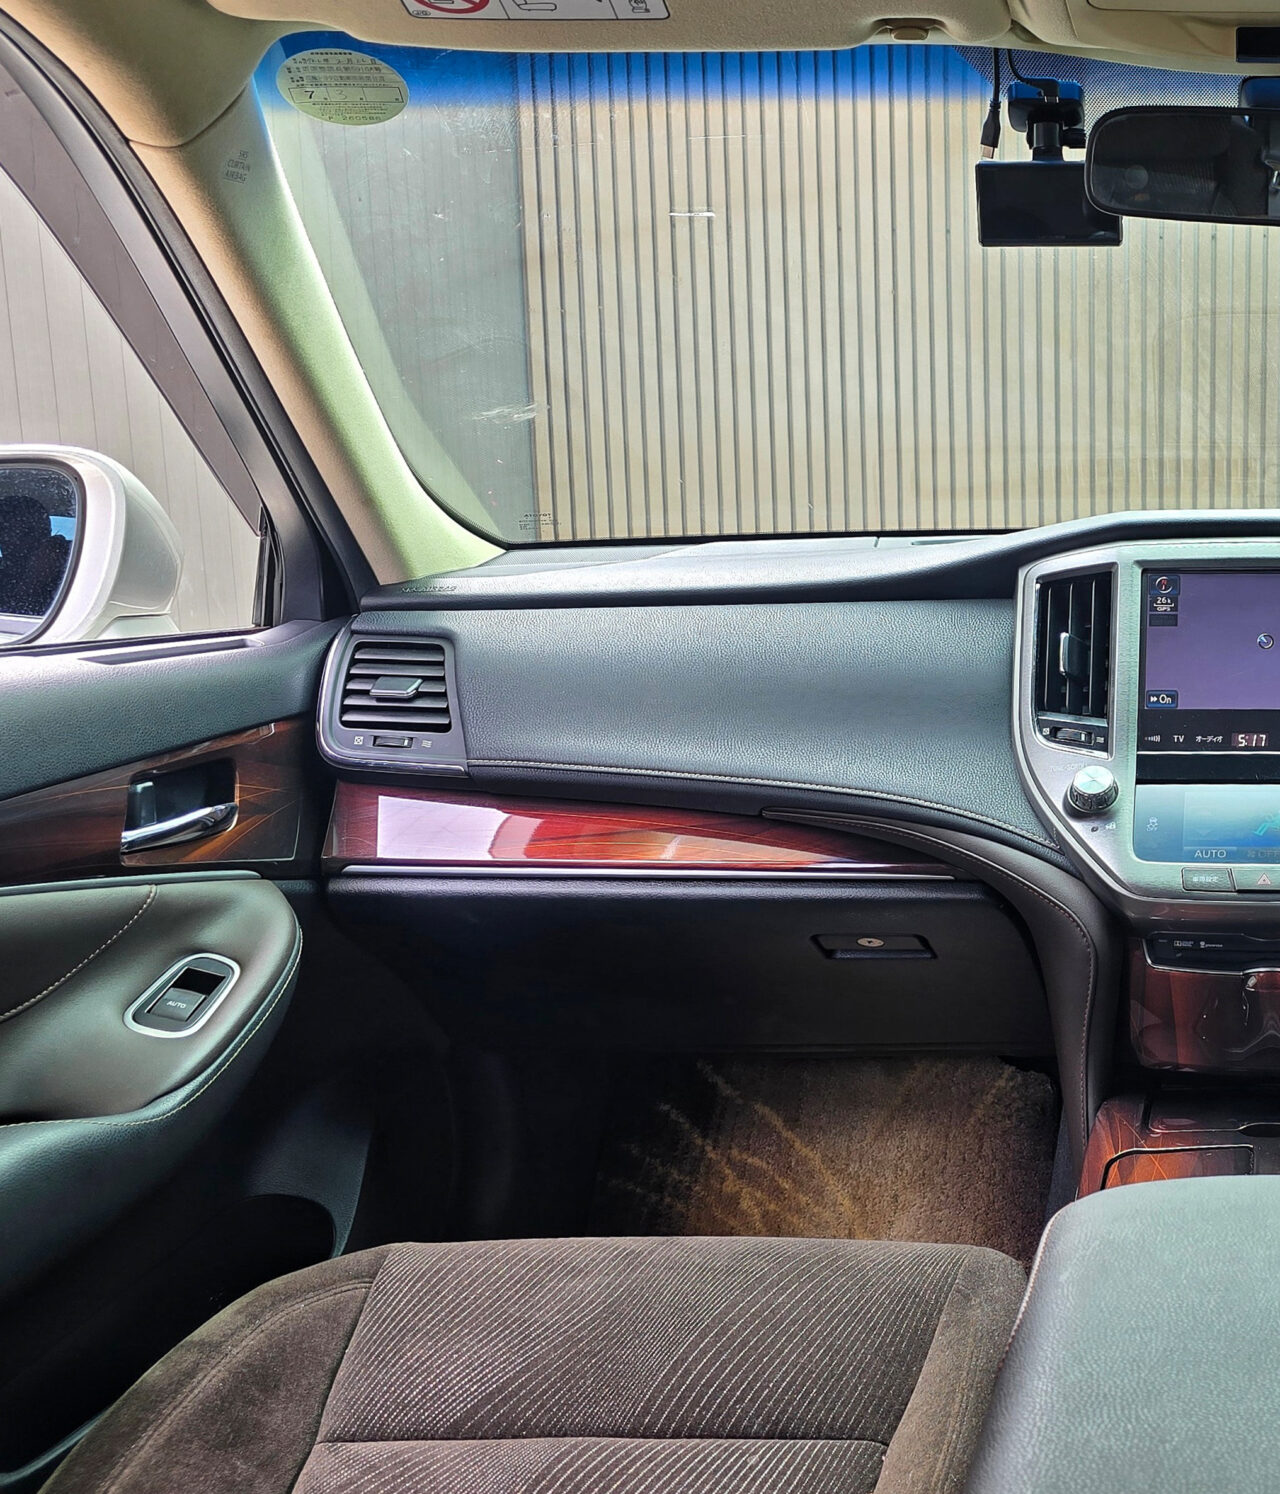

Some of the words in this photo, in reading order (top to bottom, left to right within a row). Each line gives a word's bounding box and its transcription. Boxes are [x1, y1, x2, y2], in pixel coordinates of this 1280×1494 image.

[304, 90, 315, 99] 7
[1159, 694, 1172, 704] On
[1195, 735, 1224, 743] オーディオ
[1238, 734, 1267, 747] 5:17
[1194, 850, 1227, 858] AUTO
[166, 1001, 187, 1009] AUTO
